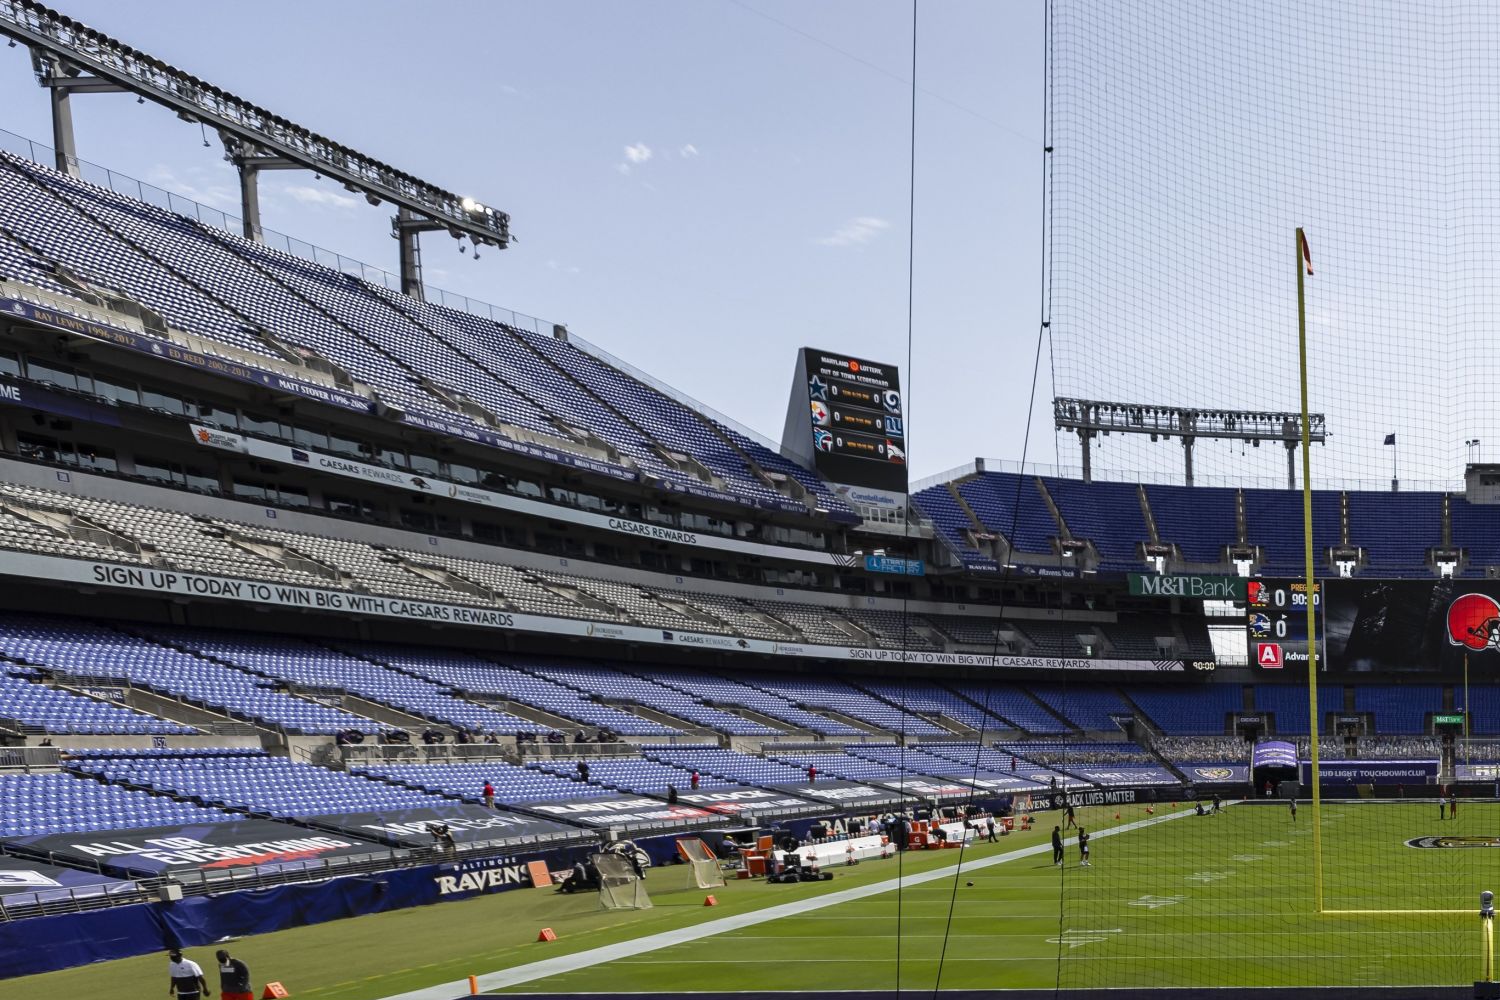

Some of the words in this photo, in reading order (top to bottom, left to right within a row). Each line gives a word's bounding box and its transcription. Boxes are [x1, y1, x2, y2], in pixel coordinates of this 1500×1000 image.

[33, 310, 53, 323] RAY
[55, 315, 86, 332] LEWIS
[87, 324, 137, 347] 1996-2012
[168, 348, 181, 359] ED
[183, 353, 205, 367] REED
[207, 358, 252, 378] 2002-2012
[820, 356, 849, 368] MARYLAND
[820, 367, 832, 376] OUT
[840, 371, 856, 382] TOWN
[856, 374, 889, 388] SCOREBOARD
[278, 379, 300, 392] MATT
[300, 385, 330, 401] STOVER
[831, 386, 838, 396] 0
[873, 394, 880, 403] 0
[404, 413, 426, 427] JAMAL
[426, 418, 447, 432] LEWIS
[834, 411, 841, 422] 0
[876, 419, 882, 429] 0
[496, 438, 514, 450] TODD
[513, 441, 530, 454] HEAP
[836, 436, 843, 447] 0
[878, 444, 884, 453] 0
[319, 458, 360, 474] CAESARS
[608, 517, 652, 537] CAESARS
[652, 525, 697, 545] REWARDS
[968, 564, 998, 572] RAVENS
[1140, 574, 1189, 596] M&T
[1189, 577, 1236, 598] Bank
[93, 564, 145, 587] SIGN
[149, 572, 178, 590] UP
[182, 575, 243, 598] TODAY
[247, 583, 272, 600] TO
[274, 587, 311, 606] WIN
[315, 591, 342, 608] BIG
[345, 595, 387, 614] WITH
[388, 600, 451, 621] CAESARS
[453, 608, 515, 627] REWARDS
[1274, 589, 1286, 607] 0
[1276, 620, 1287, 638] 0
[678, 634, 705, 645] CAESARS
[850, 648, 873, 660] SIGN
[874, 650, 888, 661] UP
[888, 650, 920, 662] TODAY
[921, 652, 934, 663] TO
[936, 653, 956, 664] WIN
[958, 654, 975, 665] BIG
[975, 655, 1000, 666] WITH
[1002, 656, 1043, 667] CAESARS
[1046, 658, 1092, 669] REWARDS
[1193, 661, 1215, 671] 90:00
[153, 738, 166, 749] 152
[1335, 769, 1358, 778] LIGHT
[1359, 769, 1408, 778] TOUCHDOWN
[1407, 769, 1427, 777] CLUB
[1085, 792, 1104, 805] LIVES
[1105, 790, 1136, 804] MATTER
[71, 843, 144, 857] ALL
[147, 836, 215, 850] OR
[453, 857, 518, 871] BALTIMORE
